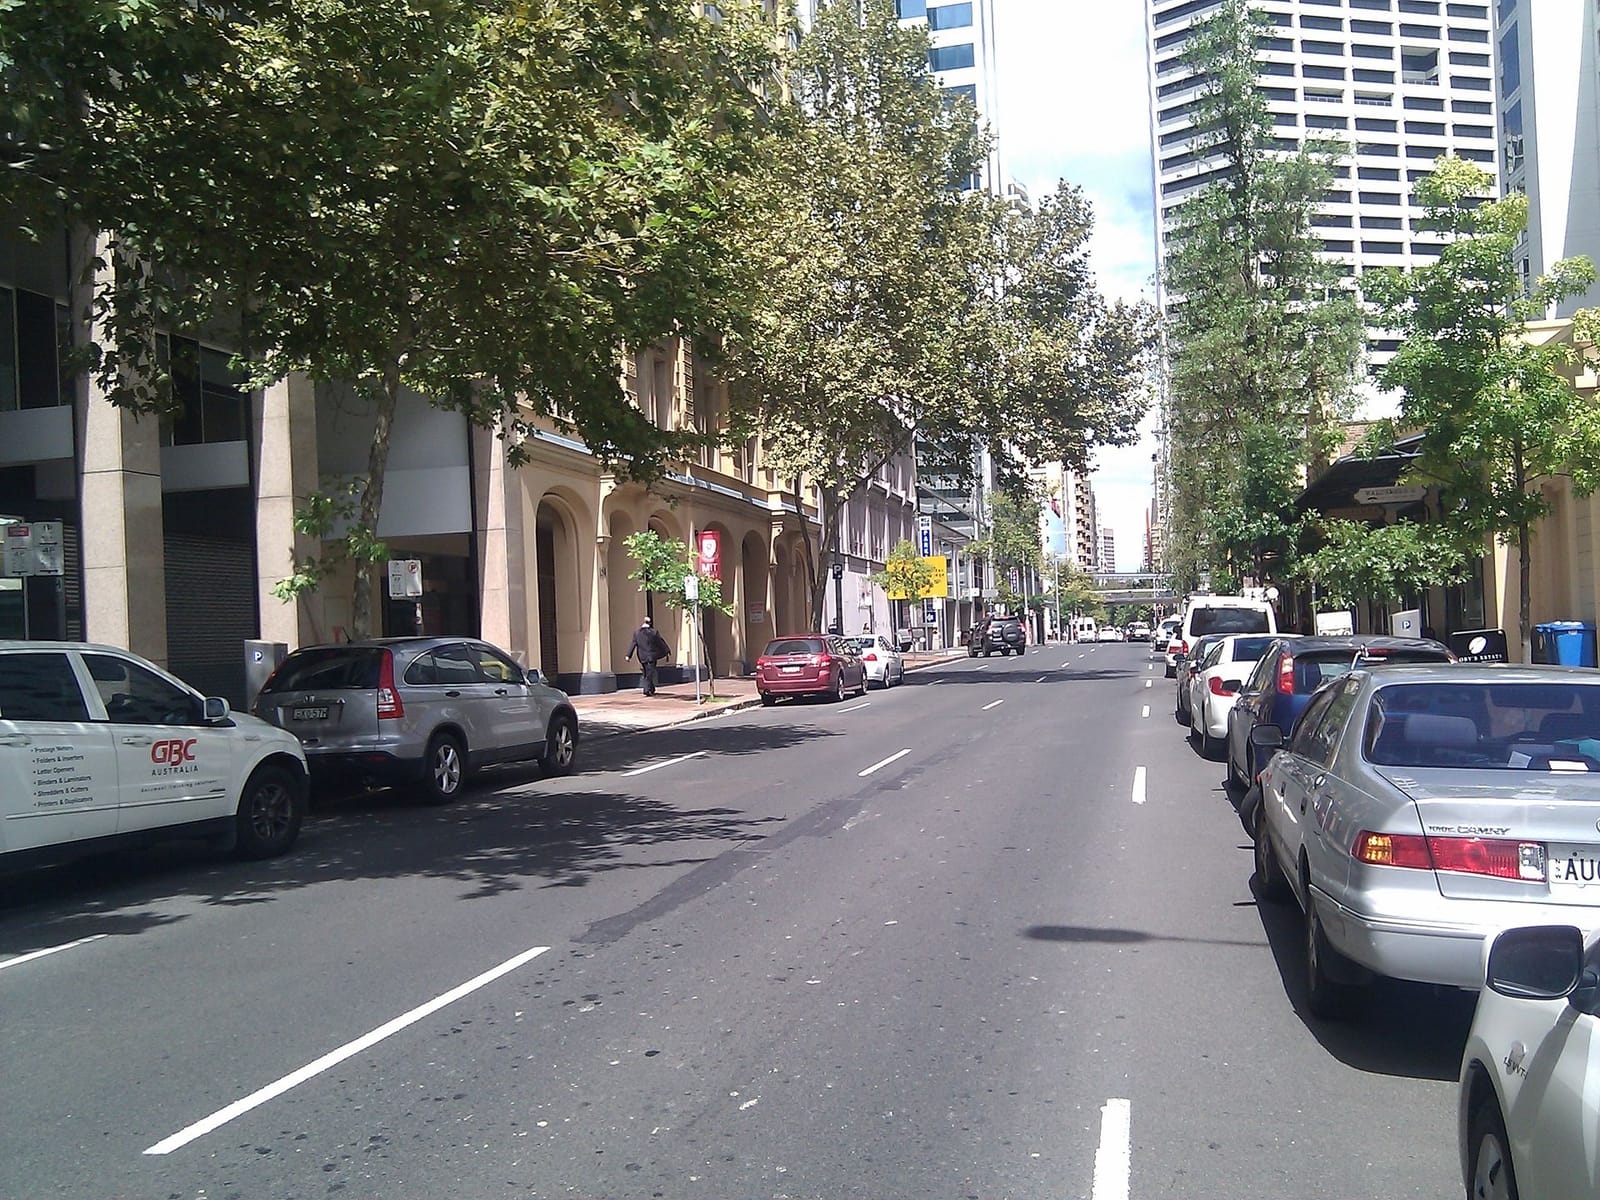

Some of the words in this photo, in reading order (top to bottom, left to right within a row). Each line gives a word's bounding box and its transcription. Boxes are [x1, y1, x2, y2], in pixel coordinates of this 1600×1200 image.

[254, 651, 262, 661] P
[151, 739, 197, 767] GBC
[151, 765, 199, 777] AUSTRALIA
[1457, 825, 1511, 836] CAMRY
